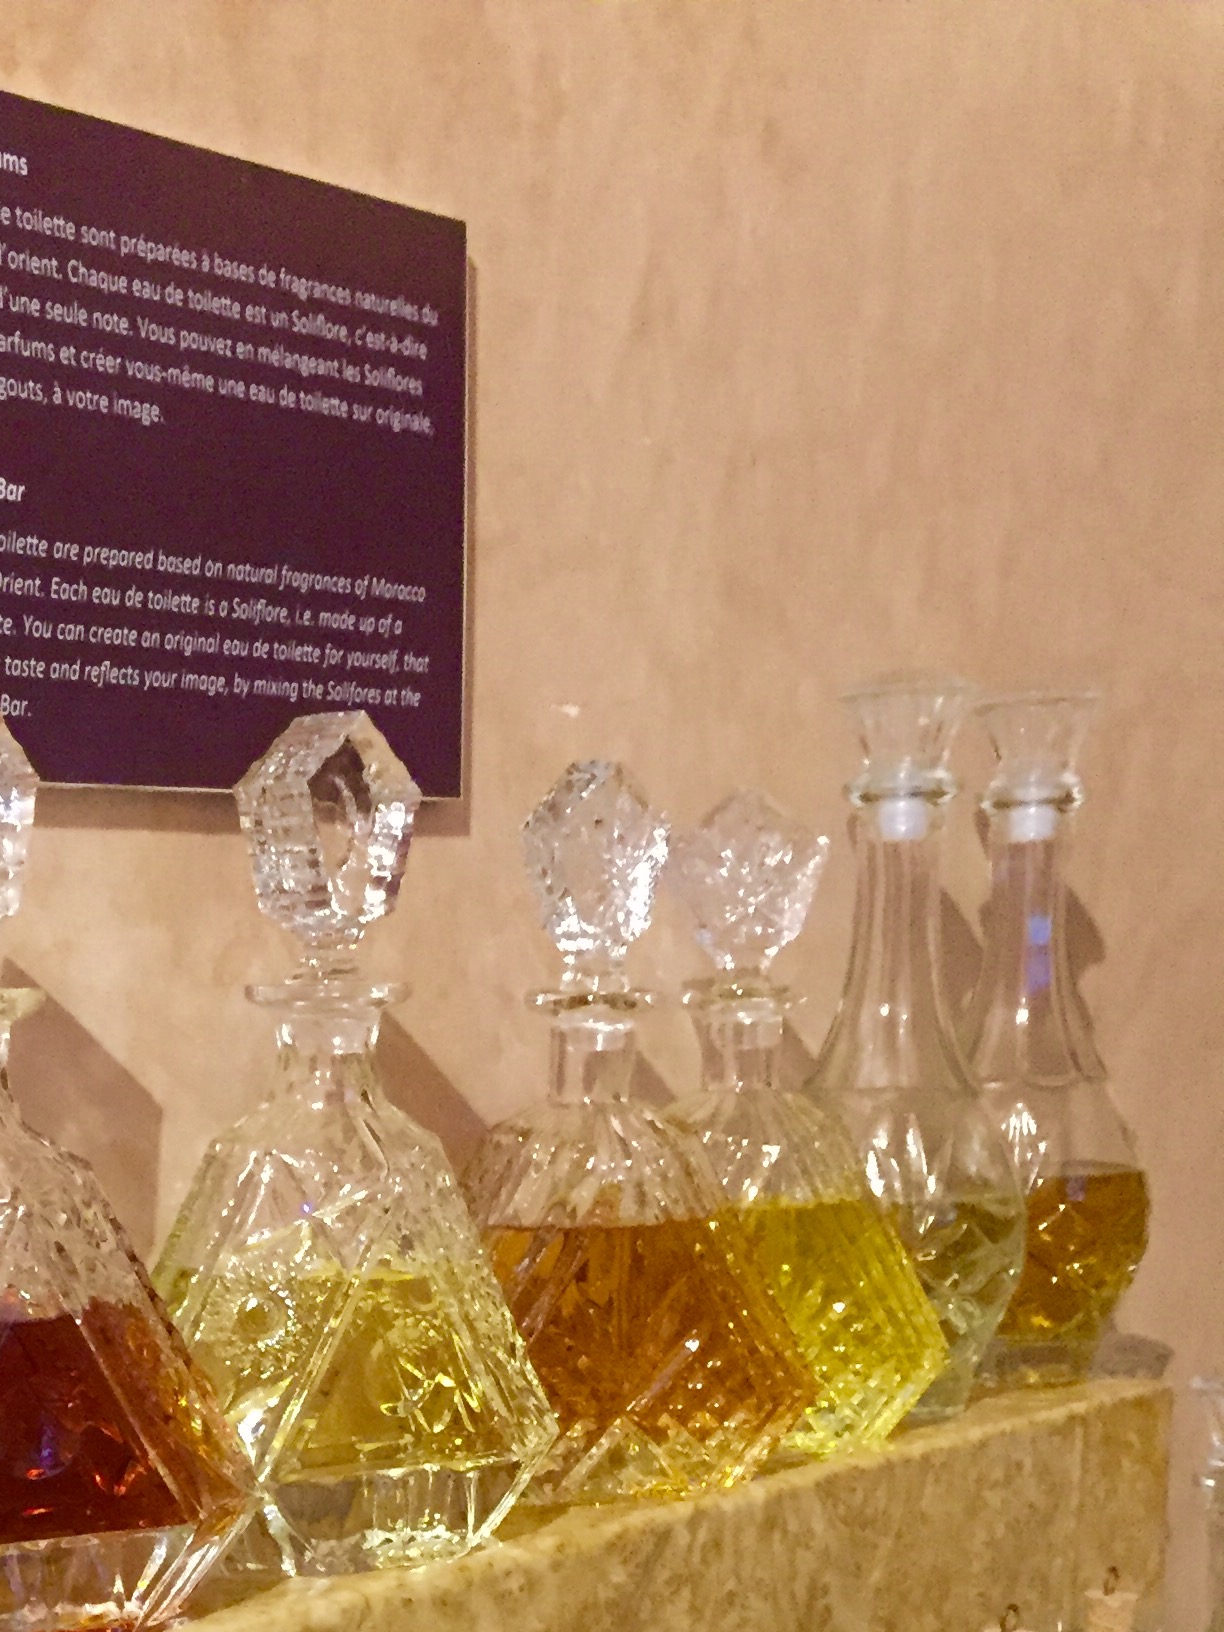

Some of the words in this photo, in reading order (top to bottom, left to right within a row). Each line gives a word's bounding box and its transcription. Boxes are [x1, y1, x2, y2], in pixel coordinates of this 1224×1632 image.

[15, 206, 77, 241] toilette
[80, 226, 116, 250] sont
[119, 233, 198, 270] préparées
[200, 248, 210, 272] à
[213, 252, 255, 283] bases
[258, 263, 277, 288] de
[278, 267, 352, 305] fragrances
[421, 303, 440, 326] du
[66, 259, 128, 294] Chaque
[132, 278, 161, 301] eau
[163, 282, 185, 307] de
[187, 288, 242, 320] toilette
[245, 304, 268, 324] est
[270, 311, 289, 328] un
[45, 300, 89, 327] seule
[92, 312, 134, 336] note.
[136, 315, 176, 345] Vous
[179, 330, 233, 358] pouvez
[235, 342, 255, 360] en
[342, 358, 361, 382] les
[52, 381, 63, 404] à
[66, 389, 109, 414] votre
[113, 392, 166, 426] image.
[59, 345, 77, 366] et
[80, 347, 122, 374] créer
[217, 378, 247, 398] une
[249, 384, 276, 403] eau
[278, 384, 297, 408] de
[299, 391, 349, 418] toilette
[53, 542, 79, 560] are
[82, 546, 155, 569] prepared
[156, 549, 202, 575] based
[204, 560, 224, 577] on
[226, 563, 278, 584] natural
[278, 564, 352, 594] fragrances
[353, 575, 370, 600] of
[371, 577, 427, 602] Morocco
[50, 577, 88, 601] Each
[91, 587, 121, 606] eau
[124, 585, 144, 608] de
[147, 589, 200, 614] toilette
[204, 594, 216, 615] is
[218, 600, 229, 617] a
[318, 610, 356, 630] made
[358, 617, 375, 636] up
[377, 614, 394, 638] of
[393, 620, 403, 634] a
[22, 614, 53, 638] You
[56, 624, 85, 641] can
[88, 626, 137, 646] create
[140, 631, 161, 647] an
[163, 631, 221, 656] original
[222, 639, 249, 656] eau
[252, 639, 270, 658] de
[272, 641, 322, 663] toilette
[322, 643, 344, 668] for
[403, 652, 430, 673] that
[0, 694, 33, 719] Bar.
[4, 656, 45, 678] taste
[49, 659, 81, 681] and
[83, 661, 141, 687] reflects
[143, 671, 179, 690] your
[180, 670, 230, 696] image,
[233, 672, 251, 698] by
[252, 680, 299, 702] mixing
[301, 679, 325, 700] the
[383, 688, 398, 705] at
[400, 686, 422, 707] the
